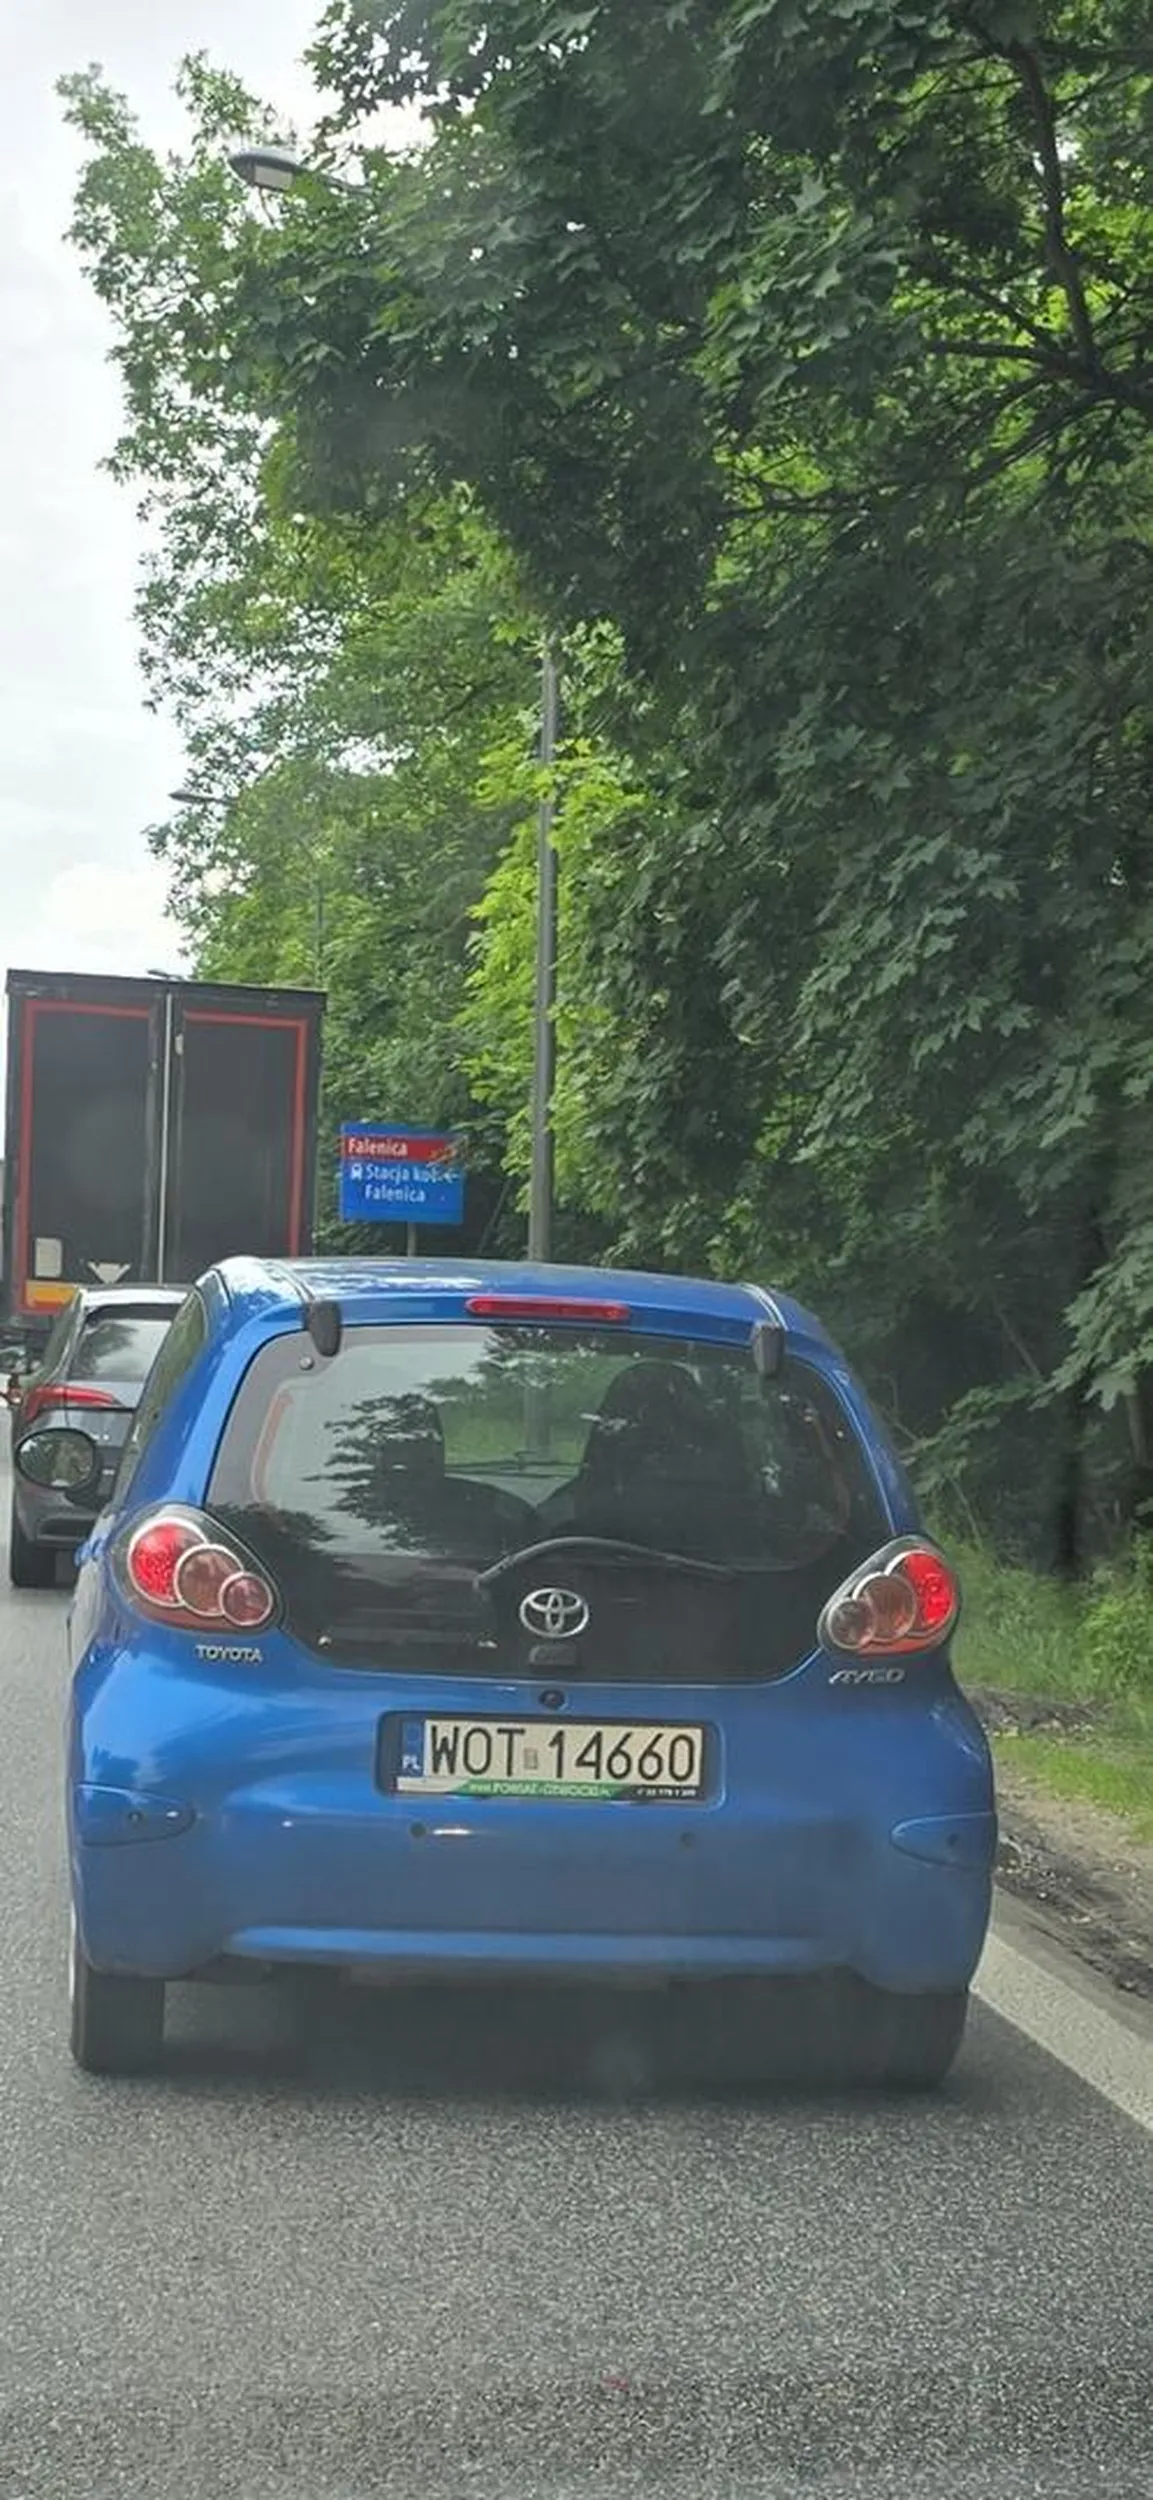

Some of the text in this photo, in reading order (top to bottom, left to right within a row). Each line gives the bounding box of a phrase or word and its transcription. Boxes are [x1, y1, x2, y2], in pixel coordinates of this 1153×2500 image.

[348, 1137, 408, 1157] Falenica
[366, 1163, 410, 1185] Stacja
[364, 1184, 426, 1204] Falenica
[195, 1644, 263, 1663] TOYOTA
[402, 1755, 420, 1770] PL
[430, 1724, 695, 1782] WOT 14660
